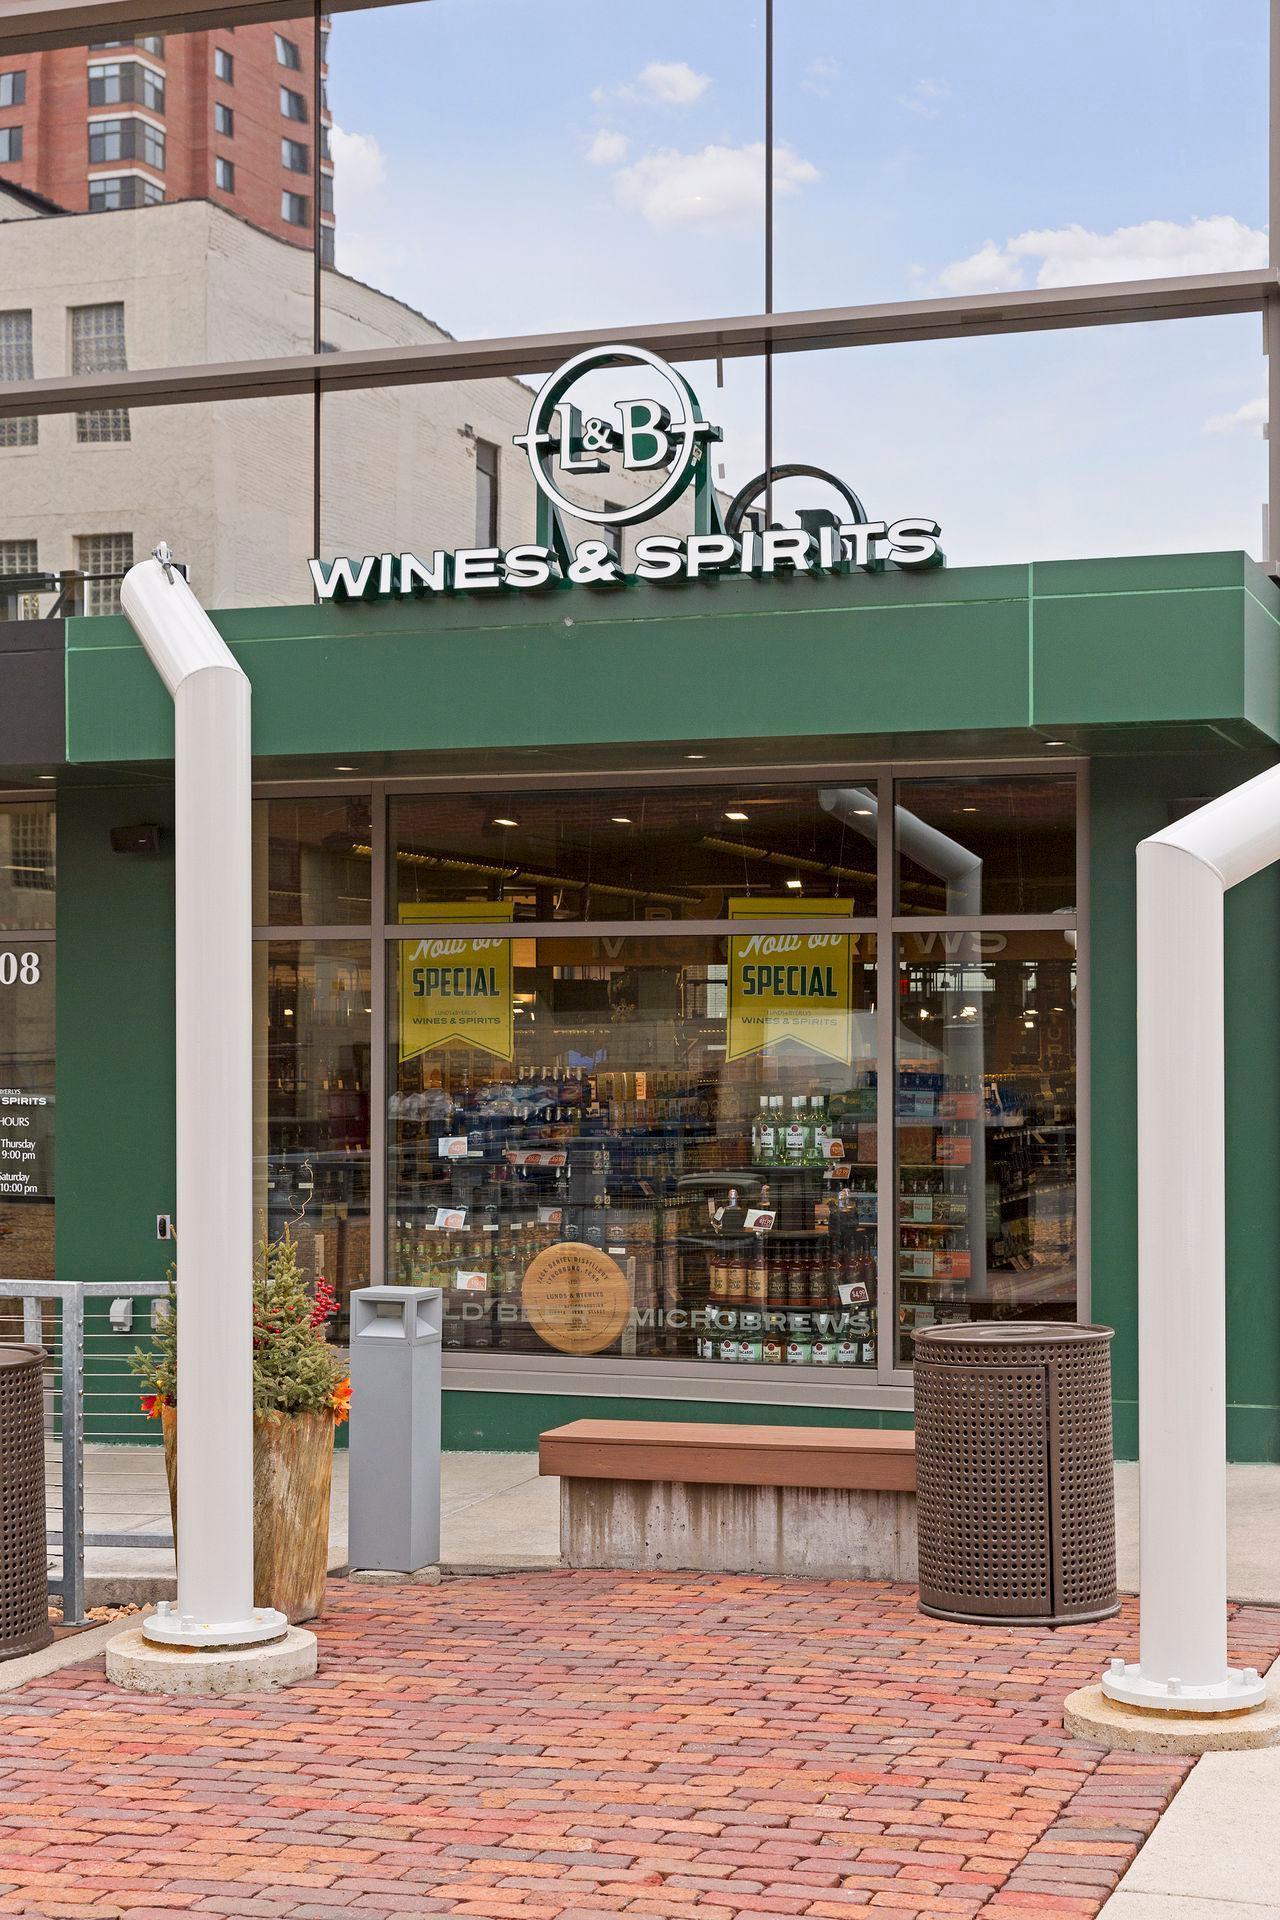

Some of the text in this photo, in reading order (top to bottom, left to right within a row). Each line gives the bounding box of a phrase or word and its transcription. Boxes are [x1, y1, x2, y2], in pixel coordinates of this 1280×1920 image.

[554, 399, 672, 471] L&B
[307, 518, 943, 600] WINES & SPIRITS
[0, 952, 40, 985] 08
[412, 967, 500, 997] SPECIAL
[742, 964, 838, 997] SPECIAL
[412, 1017, 501, 1025] WINES & SPIRITS
[741, 1017, 838, 1026] WINES & SPIRITS
[1, 1096, 47, 1106] SPIRITS
[2, 1138, 36, 1152] Thursday
[1, 1150, 36, 1162] 9:00 pm
[0, 1183, 38, 1195] 10:00 pm
[536, 1256, 608, 1284] JACK DANIEL DISTILLERY
[575, 1291, 604, 1299] BYERLYS
[628, 1306, 871, 1335] MICROBREWS
